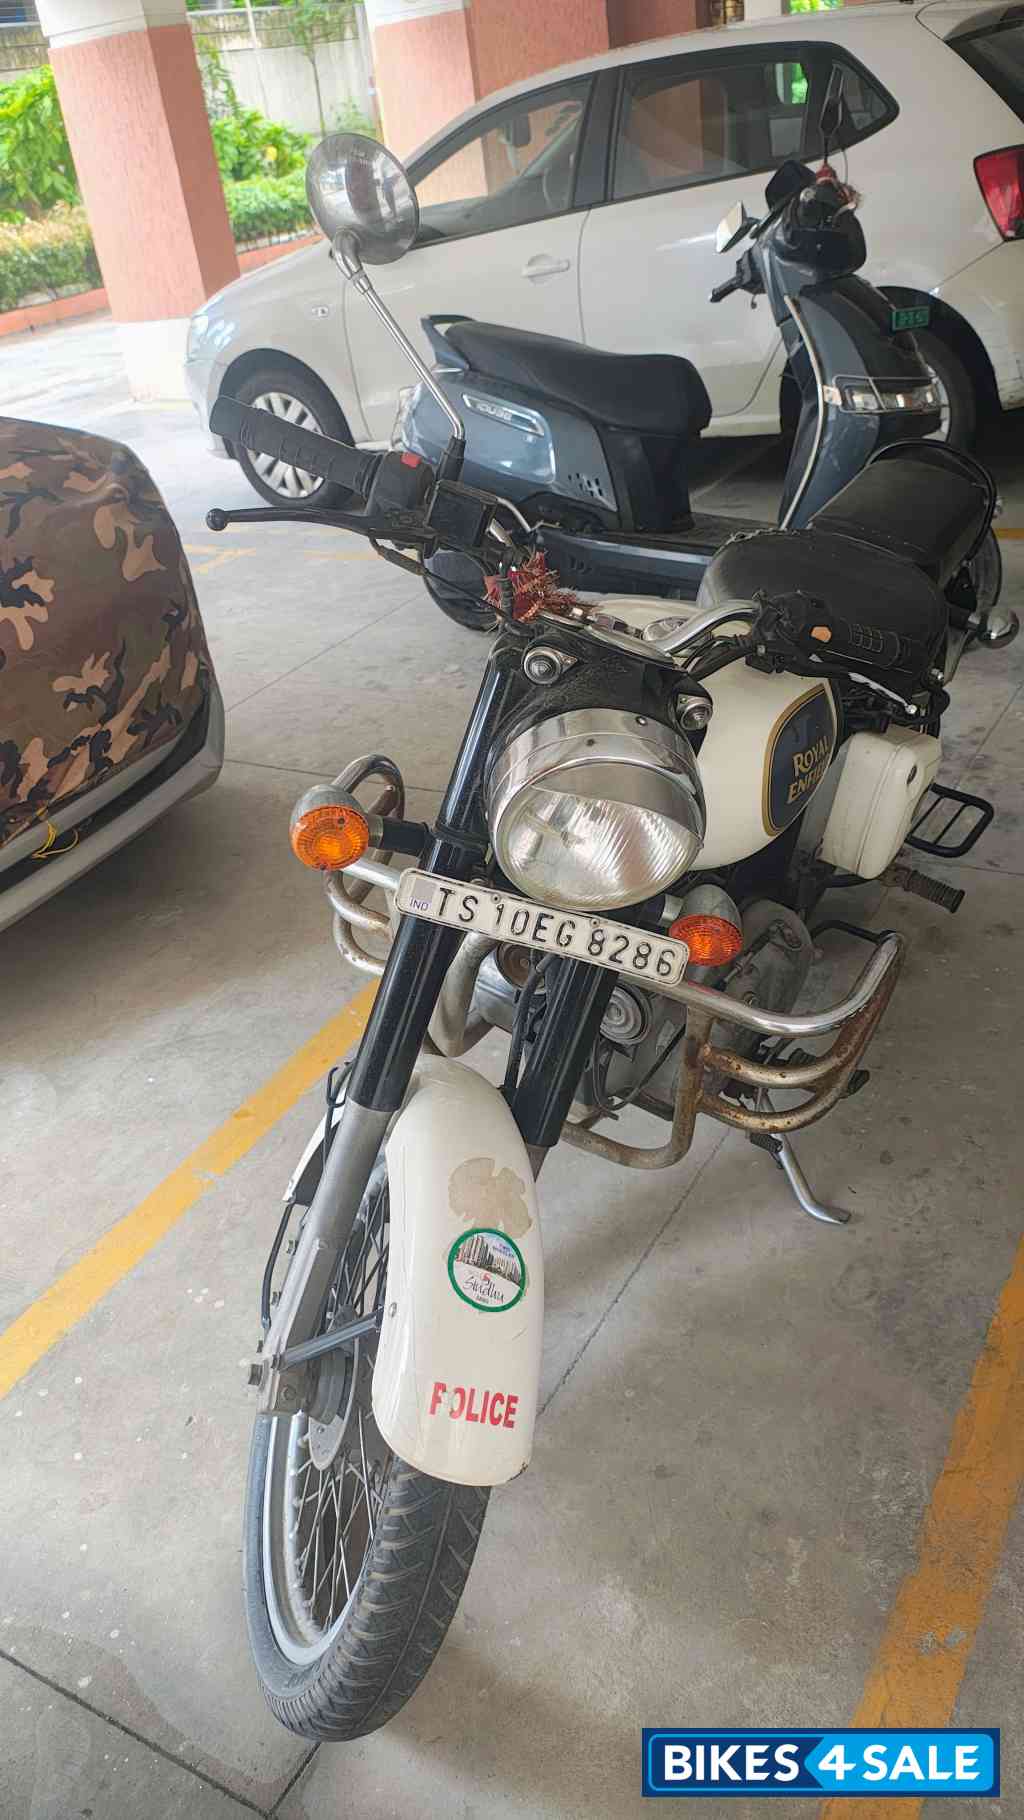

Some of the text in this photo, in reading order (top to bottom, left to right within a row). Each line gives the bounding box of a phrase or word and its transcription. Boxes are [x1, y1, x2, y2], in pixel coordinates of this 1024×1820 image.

[793, 735, 831, 778] ROYAL
[409, 898, 429, 912] IND
[437, 887, 676, 976] TS 10EG 8286
[429, 1381, 519, 1429] POLICE
